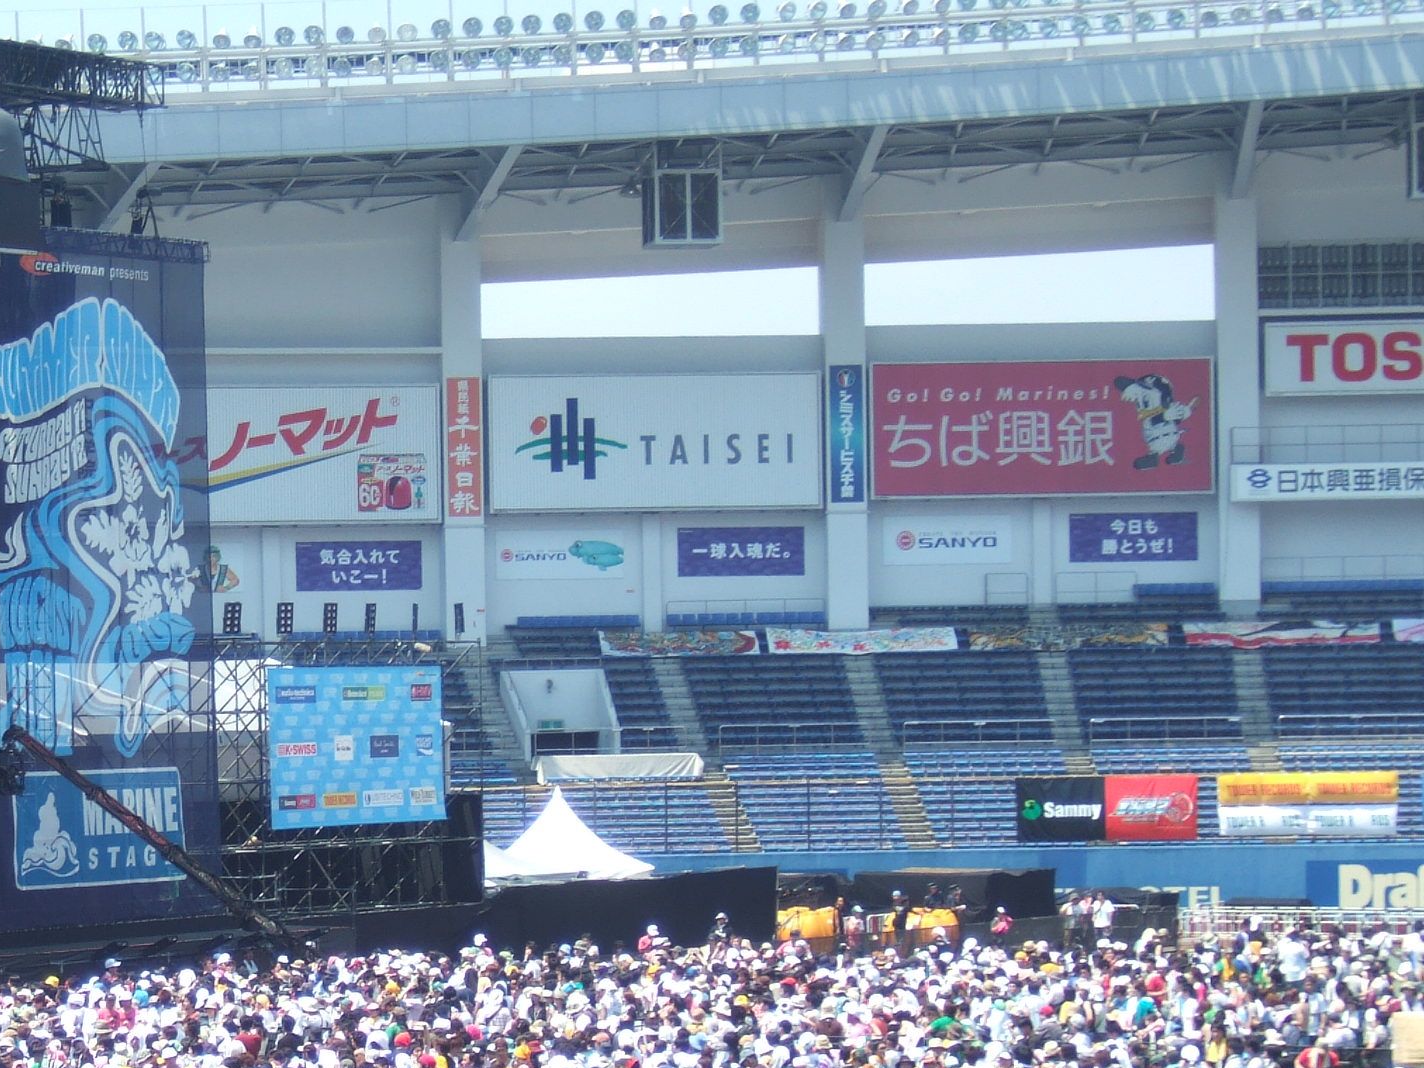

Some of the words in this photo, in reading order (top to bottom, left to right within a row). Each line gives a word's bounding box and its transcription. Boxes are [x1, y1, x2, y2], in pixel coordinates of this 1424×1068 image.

[35, 259, 104, 277] creativeman
[110, 266, 149, 282] presents
[1286, 331, 1423, 382] TOS
[886, 388, 929, 403] Go!
[940, 387, 982, 402] Go!
[996, 385, 1110, 401] Marines!
[882, 409, 1114, 468] ちば興銀
[640, 432, 794, 466] TAISEI
[449, 415, 479, 514] 千葉日報
[1277, 466, 1424, 493] 日本興亜損保
[1110, 518, 1158, 534] 今日も
[692, 543, 792, 560] 一球入魂だ。
[919, 536, 997, 549] SANYO
[1101, 538, 1173, 555] 勝とうぜ!
[320, 548, 399, 565] 気合入れて
[514, 552, 567, 562] SANYO
[332, 569, 388, 584] いこー!
[1043, 801, 1102, 821] Sammy
[89, 845, 173, 870] STAG
